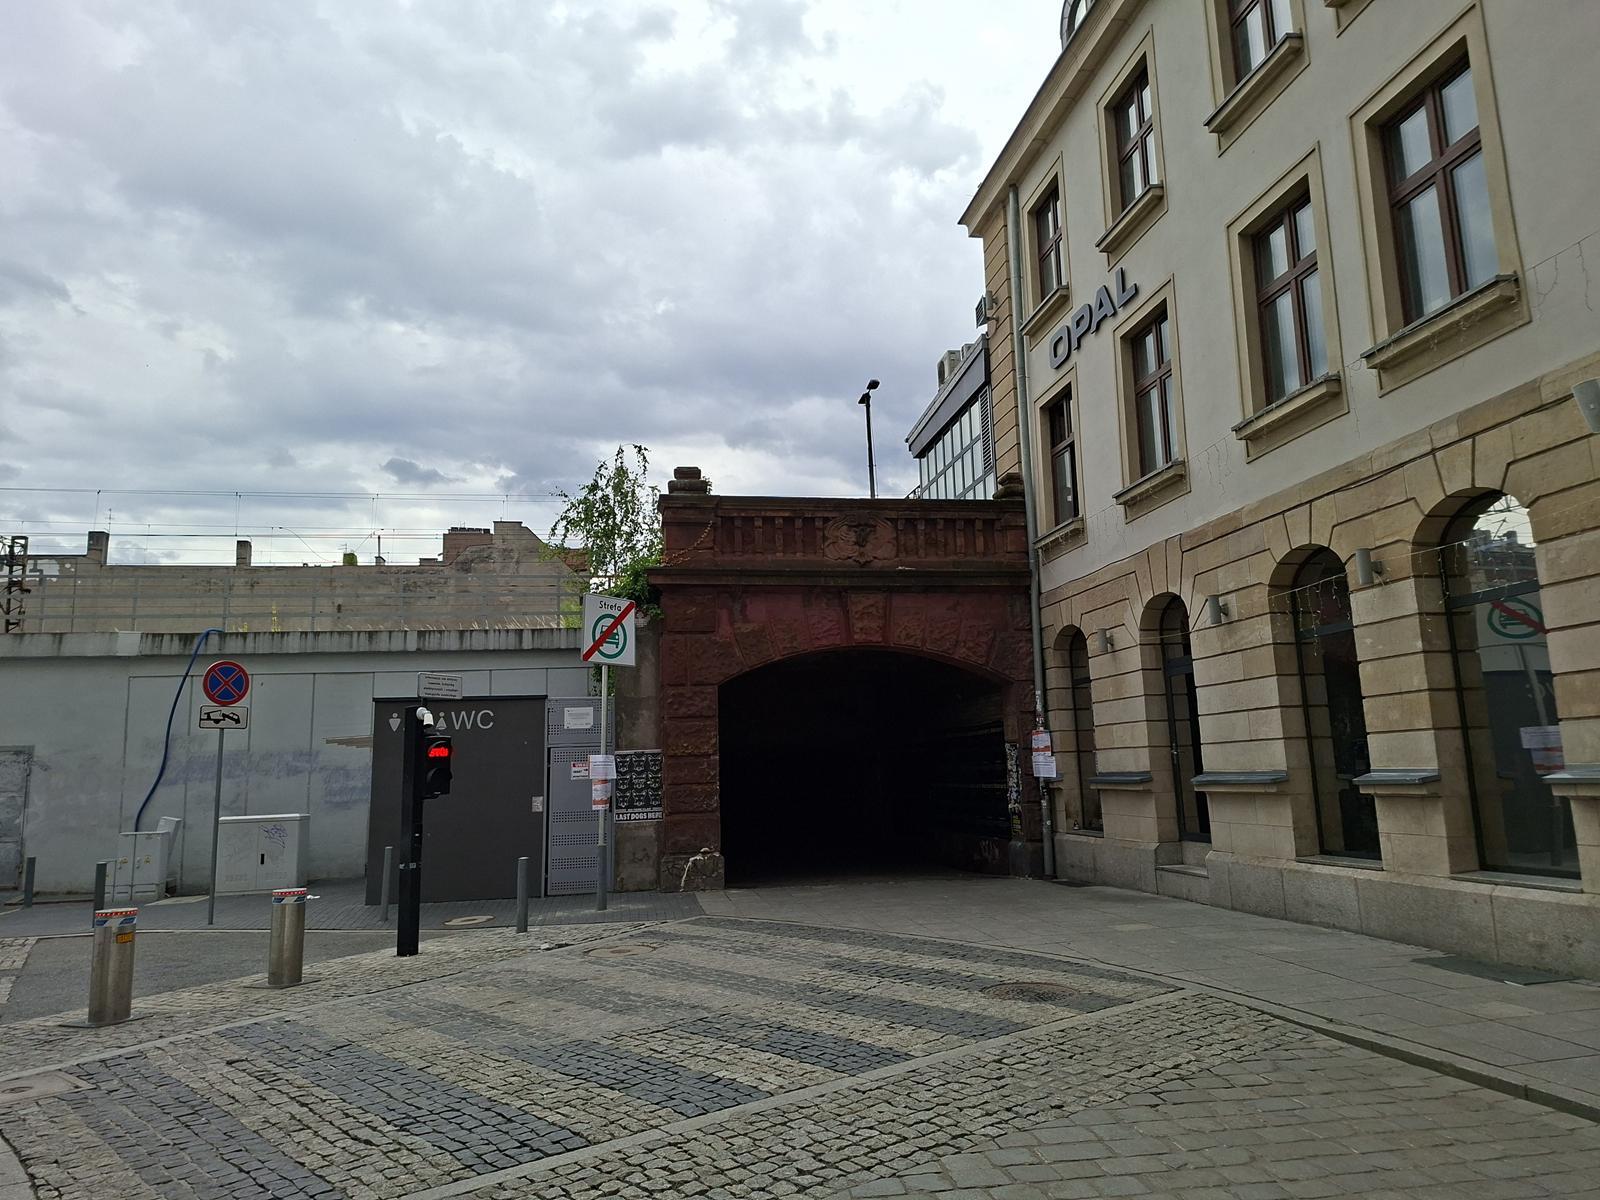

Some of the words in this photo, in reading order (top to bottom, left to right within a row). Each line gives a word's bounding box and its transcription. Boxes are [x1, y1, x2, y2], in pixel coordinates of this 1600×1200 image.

[1048, 266, 1139, 370] OPAL
[598, 600, 622, 612] Strefa
[451, 709, 494, 730] WC
[616, 813, 630, 821] LAST
[631, 813, 647, 821] DOGS
